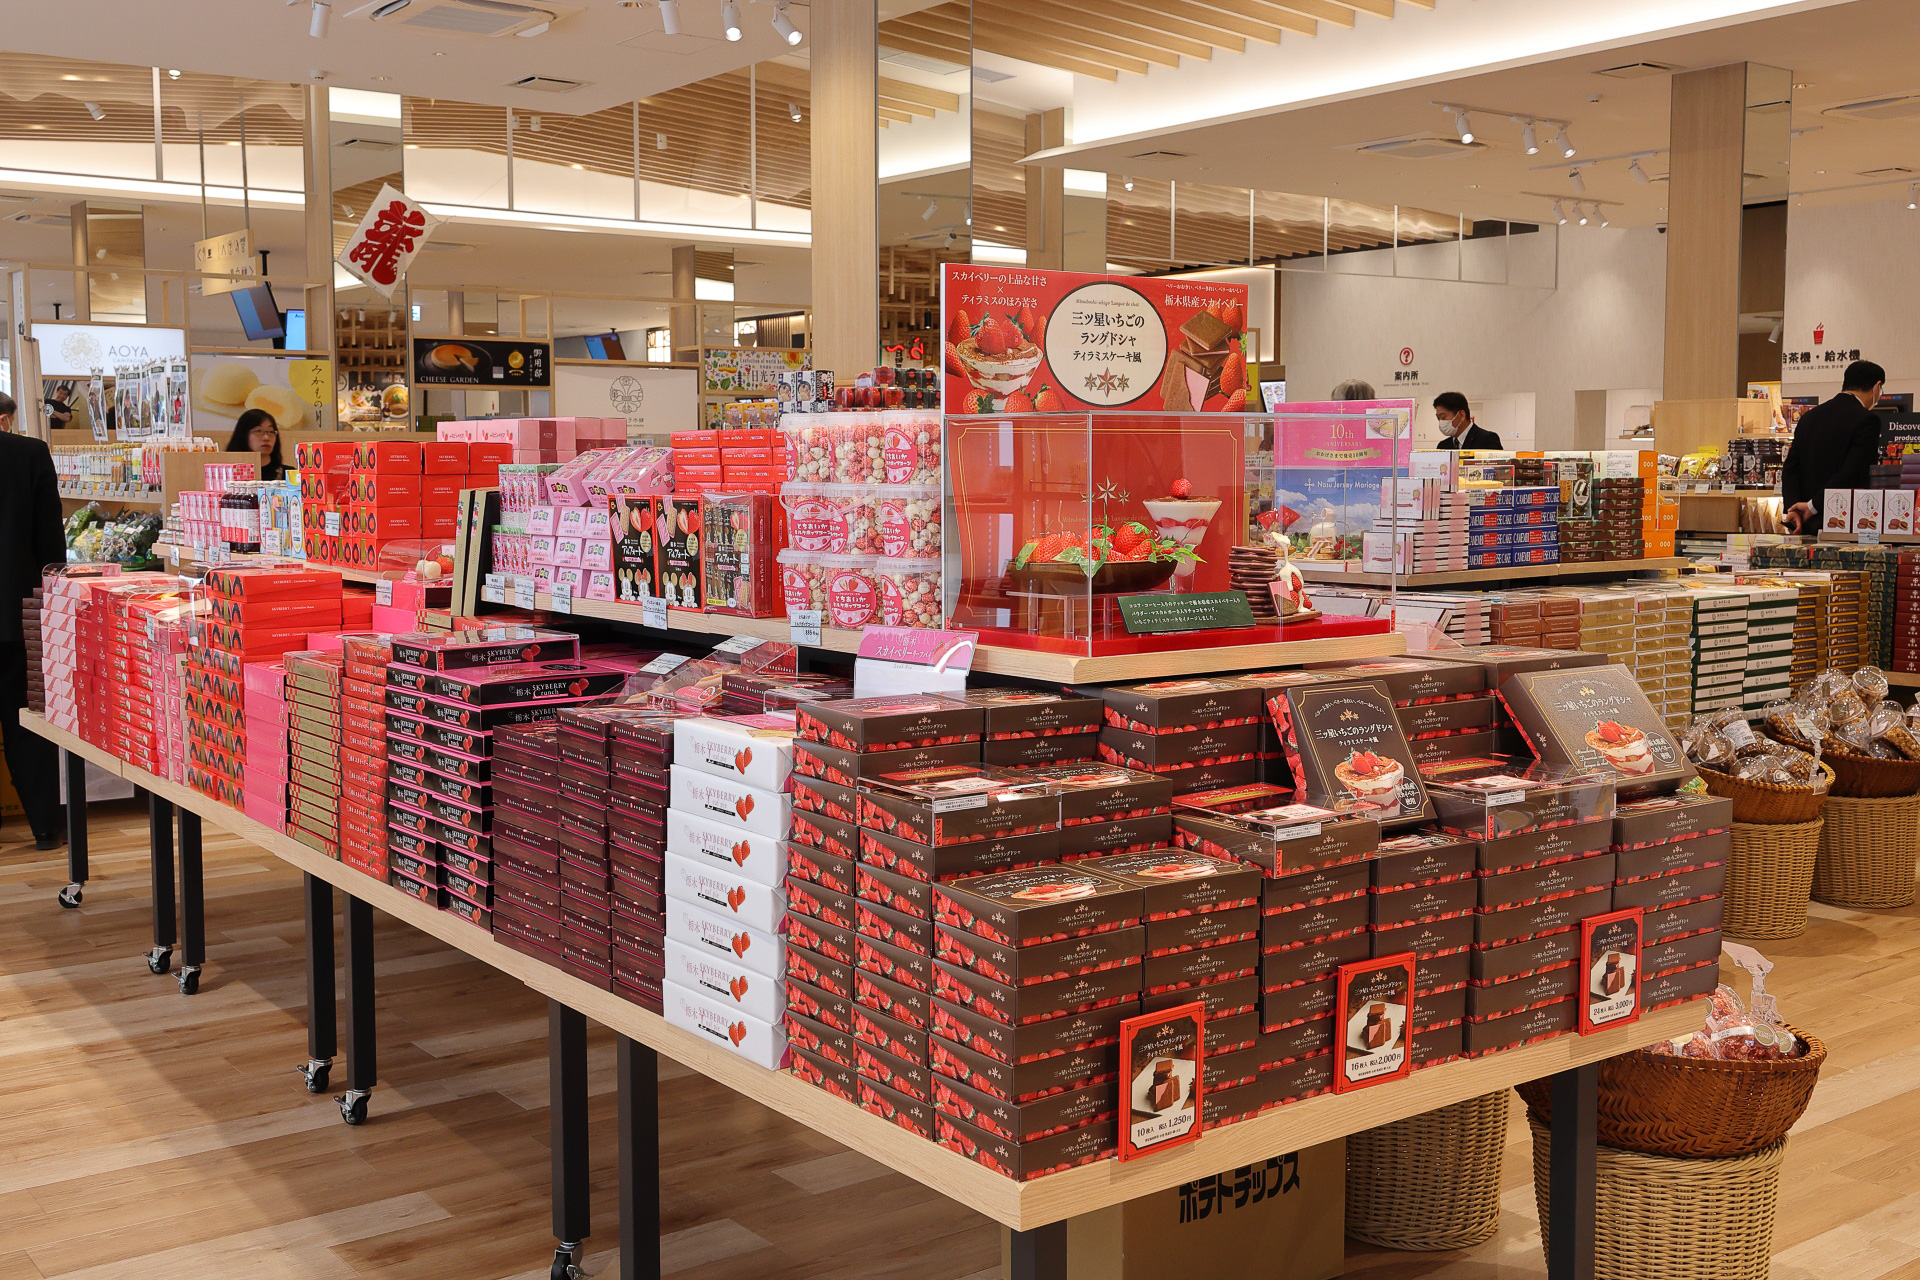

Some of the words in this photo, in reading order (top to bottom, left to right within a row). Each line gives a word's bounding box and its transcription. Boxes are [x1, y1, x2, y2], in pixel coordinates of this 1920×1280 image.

[951, 270, 1048, 287] スカイベリーの上品な甘さ
[961, 294, 1038, 308] ティラミスのほろ苦さ
[1164, 293, 1244, 309] 栃木県産スカイベリー
[1071, 311, 1145, 329] 三ツ星いちごの
[1080, 331, 1137, 348] ラングドシャ
[108, 345, 149, 357] AOYA
[1072, 349, 1142, 363] ティラミスケーキ風
[420, 375, 447, 383] CHEESE
[449, 376, 479, 384] GARDEN
[1394, 370, 1418, 381] 案内所
[311, 364, 323, 428] みかもの月
[1330, 423, 1354, 439] 10th
[1317, 480, 1332, 489] Nasu
[1333, 480, 1353, 490] Jersey
[1354, 480, 1380, 491] Mariage
[487, 648, 520, 656] SKYBERRY
[532, 682, 567, 691] SKYBERRY
[707, 741, 736, 756] SKYBERRY
[705, 786, 736, 803] SKYBERRY
[702, 831, 733, 849] SKYBERRY
[698, 1006, 729, 1028] SKYBERRY
[1179, 1151, 1300, 1224] ポテトチップス
